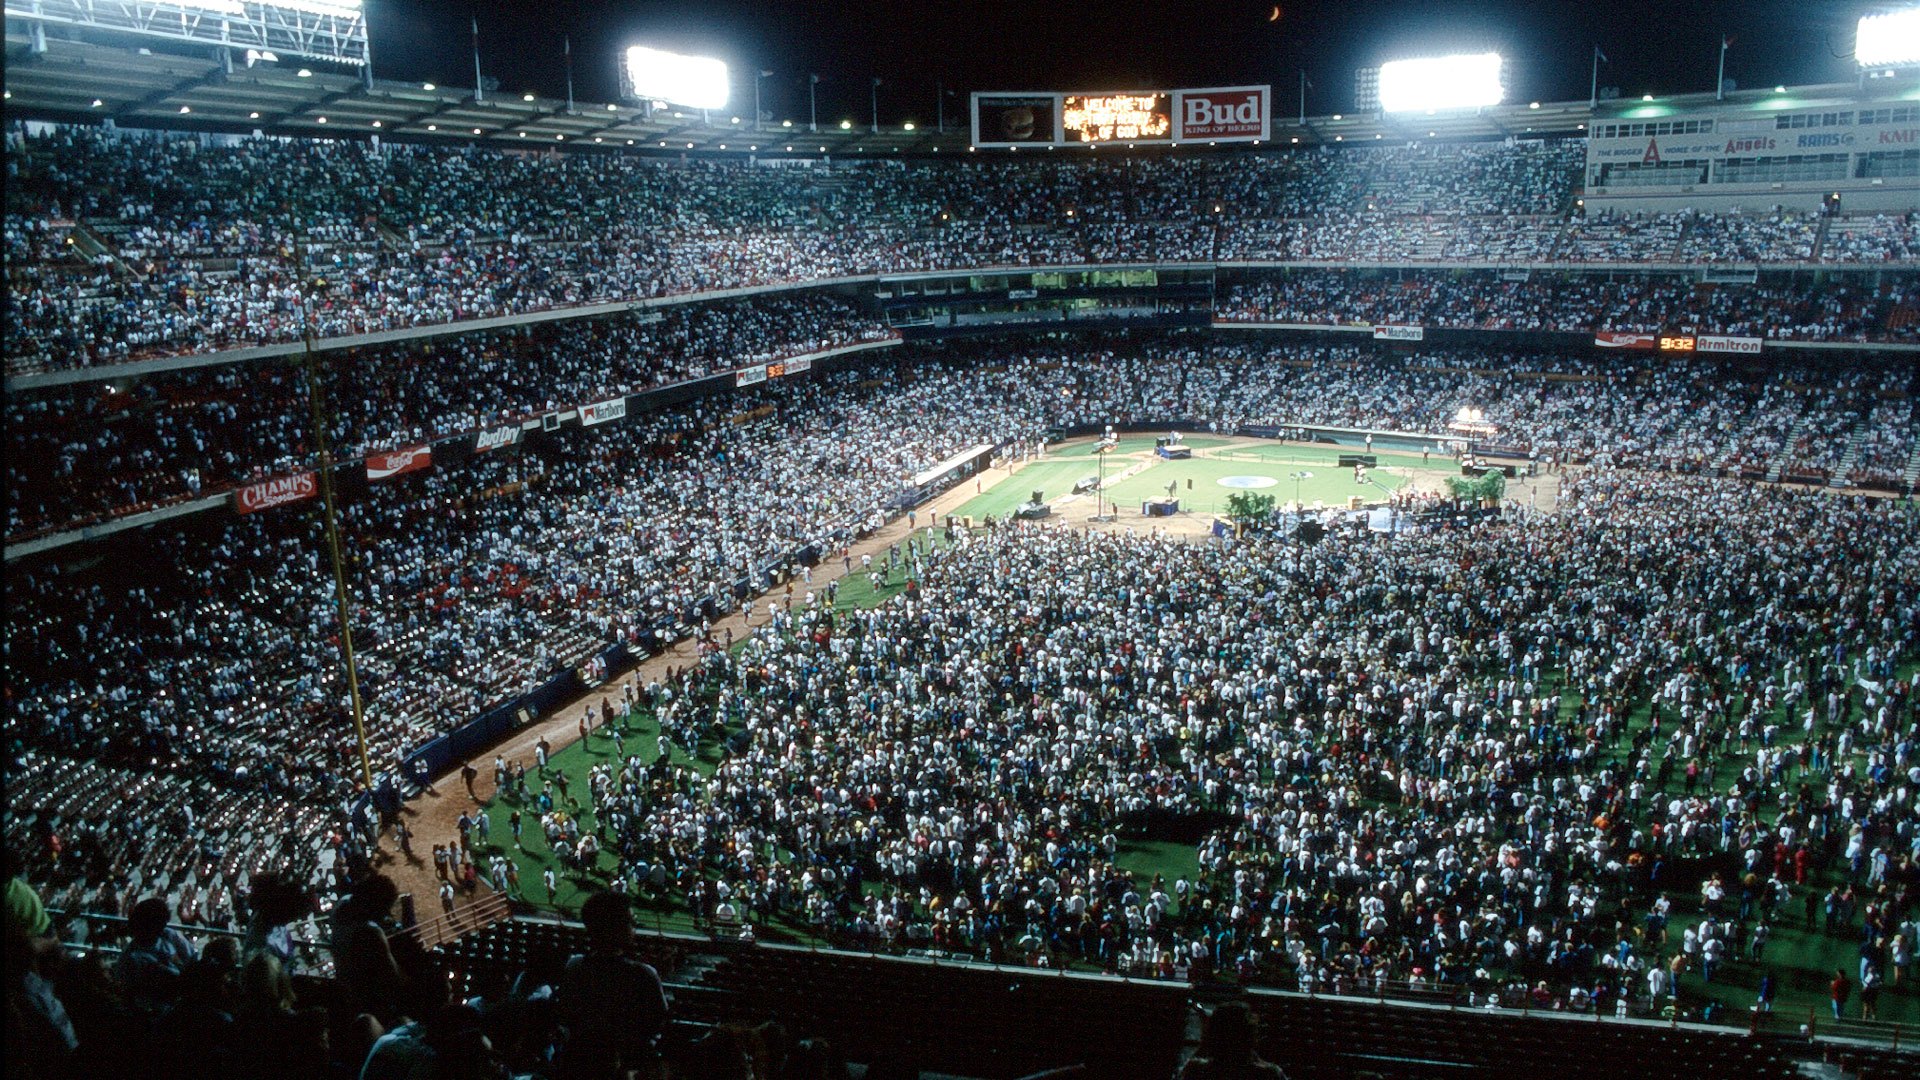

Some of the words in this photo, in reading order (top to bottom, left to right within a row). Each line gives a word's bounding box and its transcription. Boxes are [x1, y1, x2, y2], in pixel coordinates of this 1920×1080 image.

[1084, 98, 1133, 110] WELCOME
[1184, 95, 1260, 125] Bud
[1099, 126, 1113, 138] OF
[1117, 126, 1138, 138] GOD
[1185, 126, 1210, 134] KING
[1724, 136, 1776, 154] Angels
[1797, 133, 1840, 147] RAMS
[1643, 138, 1660, 163] A
[1387, 328, 1422, 341] Marlboro
[1660, 337, 1693, 349] 9:32
[1699, 338, 1759, 351] Armitron
[594, 403, 625, 420] Marlboro
[477, 427, 502, 448] Bud
[500, 426, 520, 445] Dry
[243, 473, 312, 507] CHAMPS
